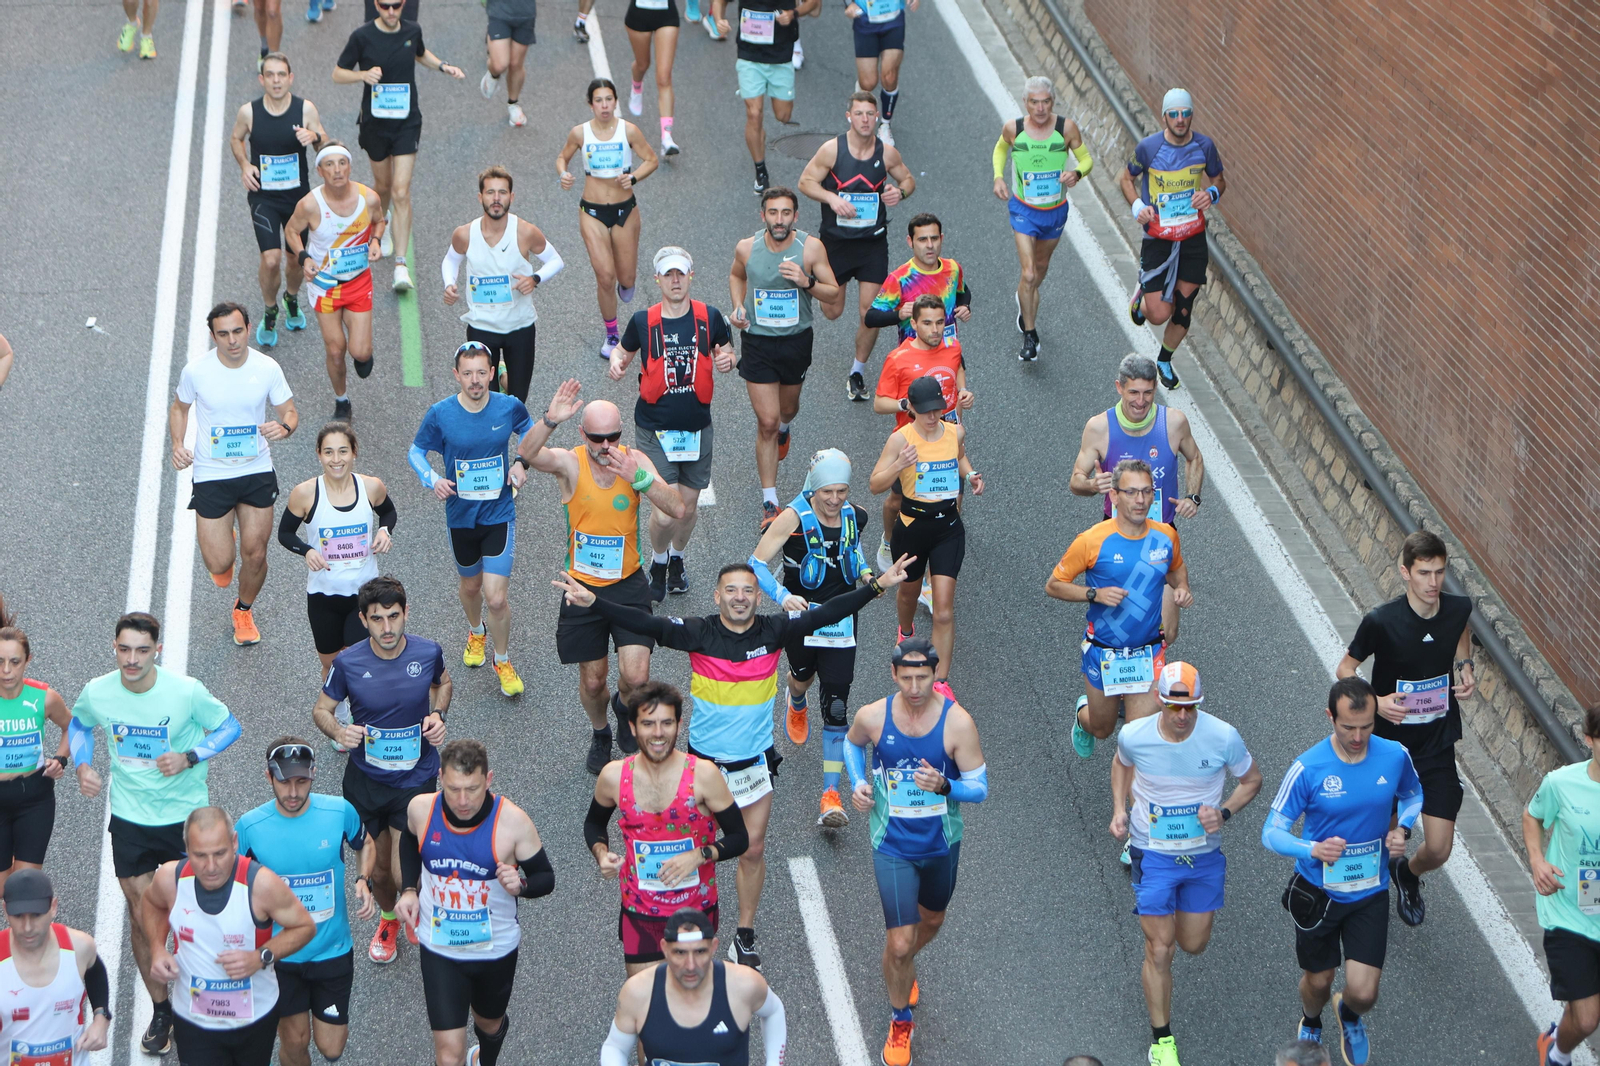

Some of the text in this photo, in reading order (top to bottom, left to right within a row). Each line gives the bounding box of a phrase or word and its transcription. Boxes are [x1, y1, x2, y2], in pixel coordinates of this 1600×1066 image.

[273, 156, 294, 165] ZURICH
[1037, 172, 1058, 180] ZURICH
[852, 194, 875, 202] ZURICH
[1171, 191, 1192, 201] ZURICH
[343, 246, 366, 256] ZURICH
[480, 277, 506, 285] ZURICH
[769, 290, 794, 299] ZURICH
[226, 427, 253, 436] ZURICH
[226, 441, 242, 449] 6337
[225, 450, 244, 458] DANIEL
[472, 460, 498, 470] ZURICH
[932, 461, 956, 471] ZURICH
[336, 527, 363, 538] ZURICH
[337, 543, 354, 551] 8408
[590, 539, 617, 547] ZURICH
[341, 551, 364, 559] VALENTE
[589, 554, 606, 563] 4412
[818, 630, 845, 638] ANDRADA
[1119, 666, 1136, 674] 6583
[1119, 676, 1144, 684] MORILLA
[1416, 680, 1443, 691] ZURICH
[1422, 704, 1445, 713] REMIGIO
[0, 716, 38, 732] RTUGAL
[132, 728, 161, 737] ZURICH
[385, 730, 414, 740] ZURICH
[7, 736, 36, 746] ZURICH
[134, 742, 151, 750] 4345
[734, 774, 751, 786] 9728
[907, 789, 924, 797] 6467
[1166, 806, 1197, 816] ZURICH
[1167, 823, 1185, 831] 3501
[653, 844, 687, 854] ZURICH
[1345, 845, 1375, 856] ZURICH
[430, 858, 489, 877] RUNNERS
[1344, 863, 1363, 872] 3605
[293, 876, 326, 887] ZURICH
[298, 894, 314, 903] 732
[450, 911, 483, 921] ZURICH
[450, 929, 470, 938] 6530
[210, 980, 244, 990] ZURICH
[210, 999, 231, 1007] 7983
[207, 1008, 237, 1017] STEFANO
[33, 1041, 67, 1055] ZURICH
